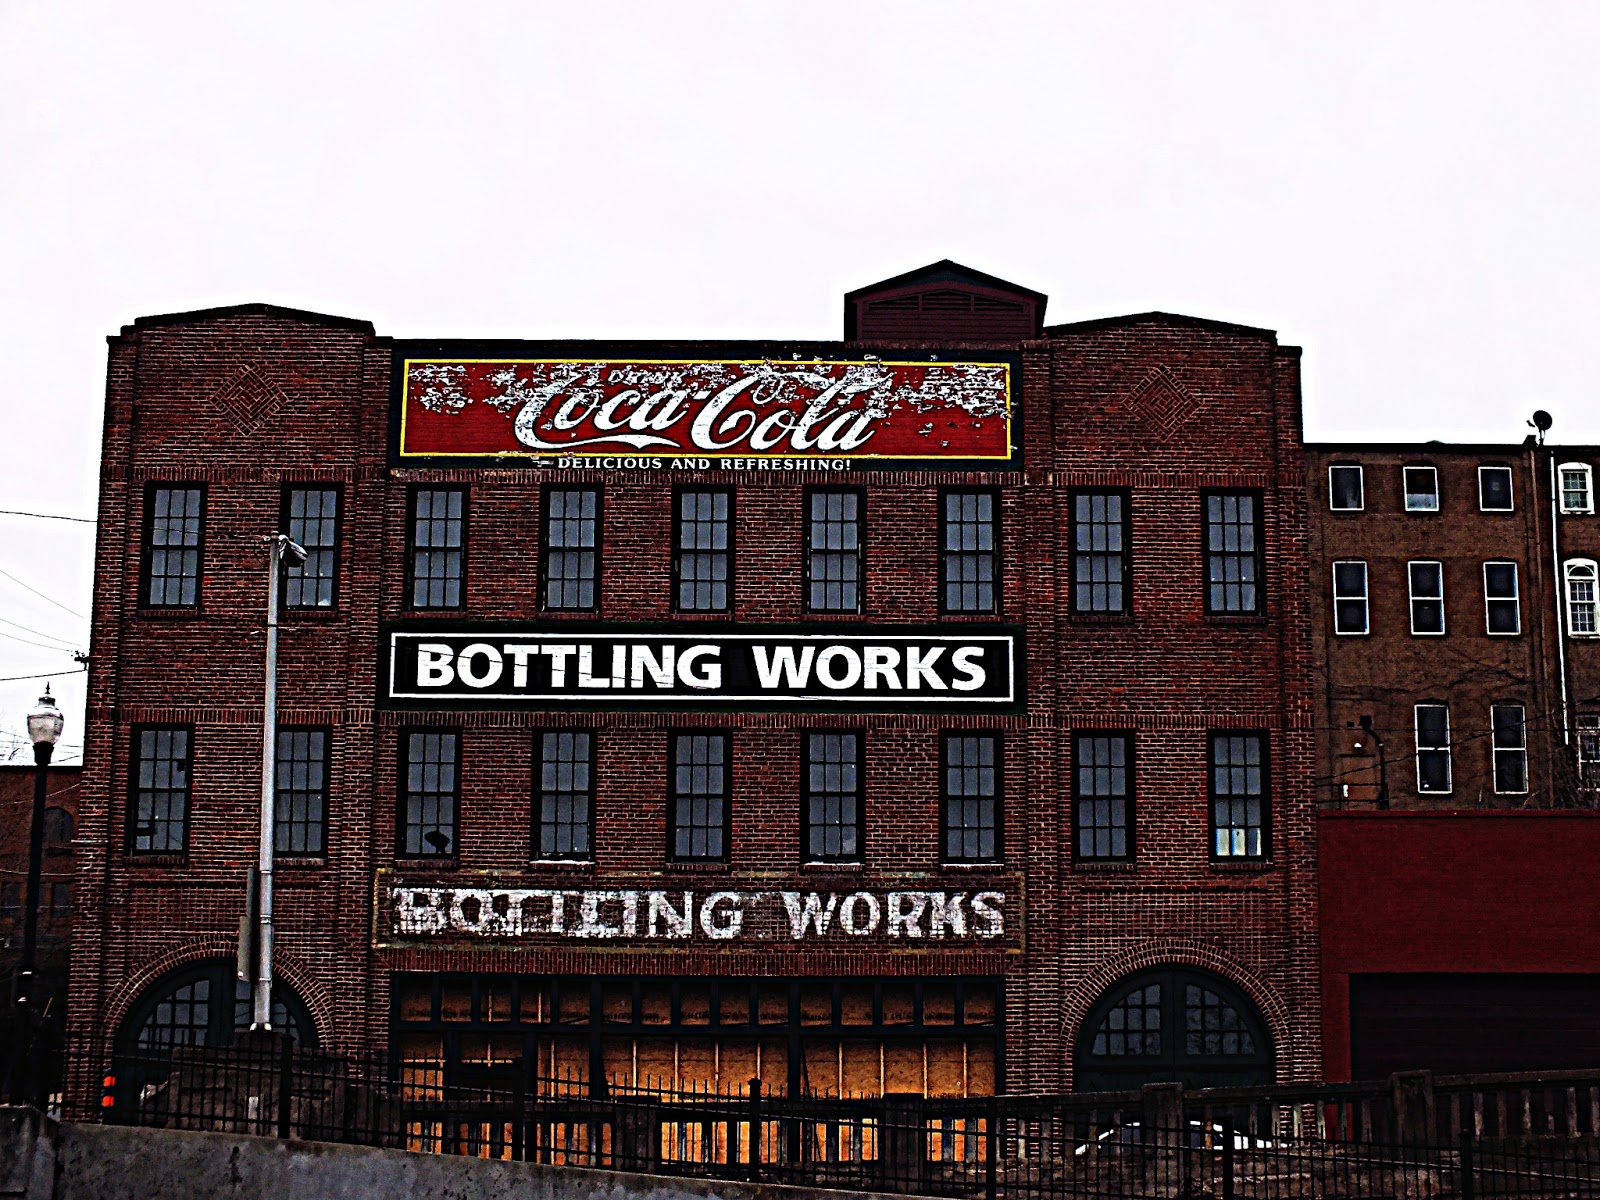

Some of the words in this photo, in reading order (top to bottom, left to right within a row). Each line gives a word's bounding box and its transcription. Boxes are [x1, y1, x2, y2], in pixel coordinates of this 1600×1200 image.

[514, 368, 894, 450] Coca-Cola
[558, 457, 662, 470] DELICIOUS
[671, 457, 711, 470] AND
[721, 458, 851, 471] REFRESHING!
[416, 643, 722, 690] BOTTLING
[752, 644, 987, 691] WORKS
[393, 888, 743, 939] BOTTLING
[781, 890, 1006, 940] WORKS
